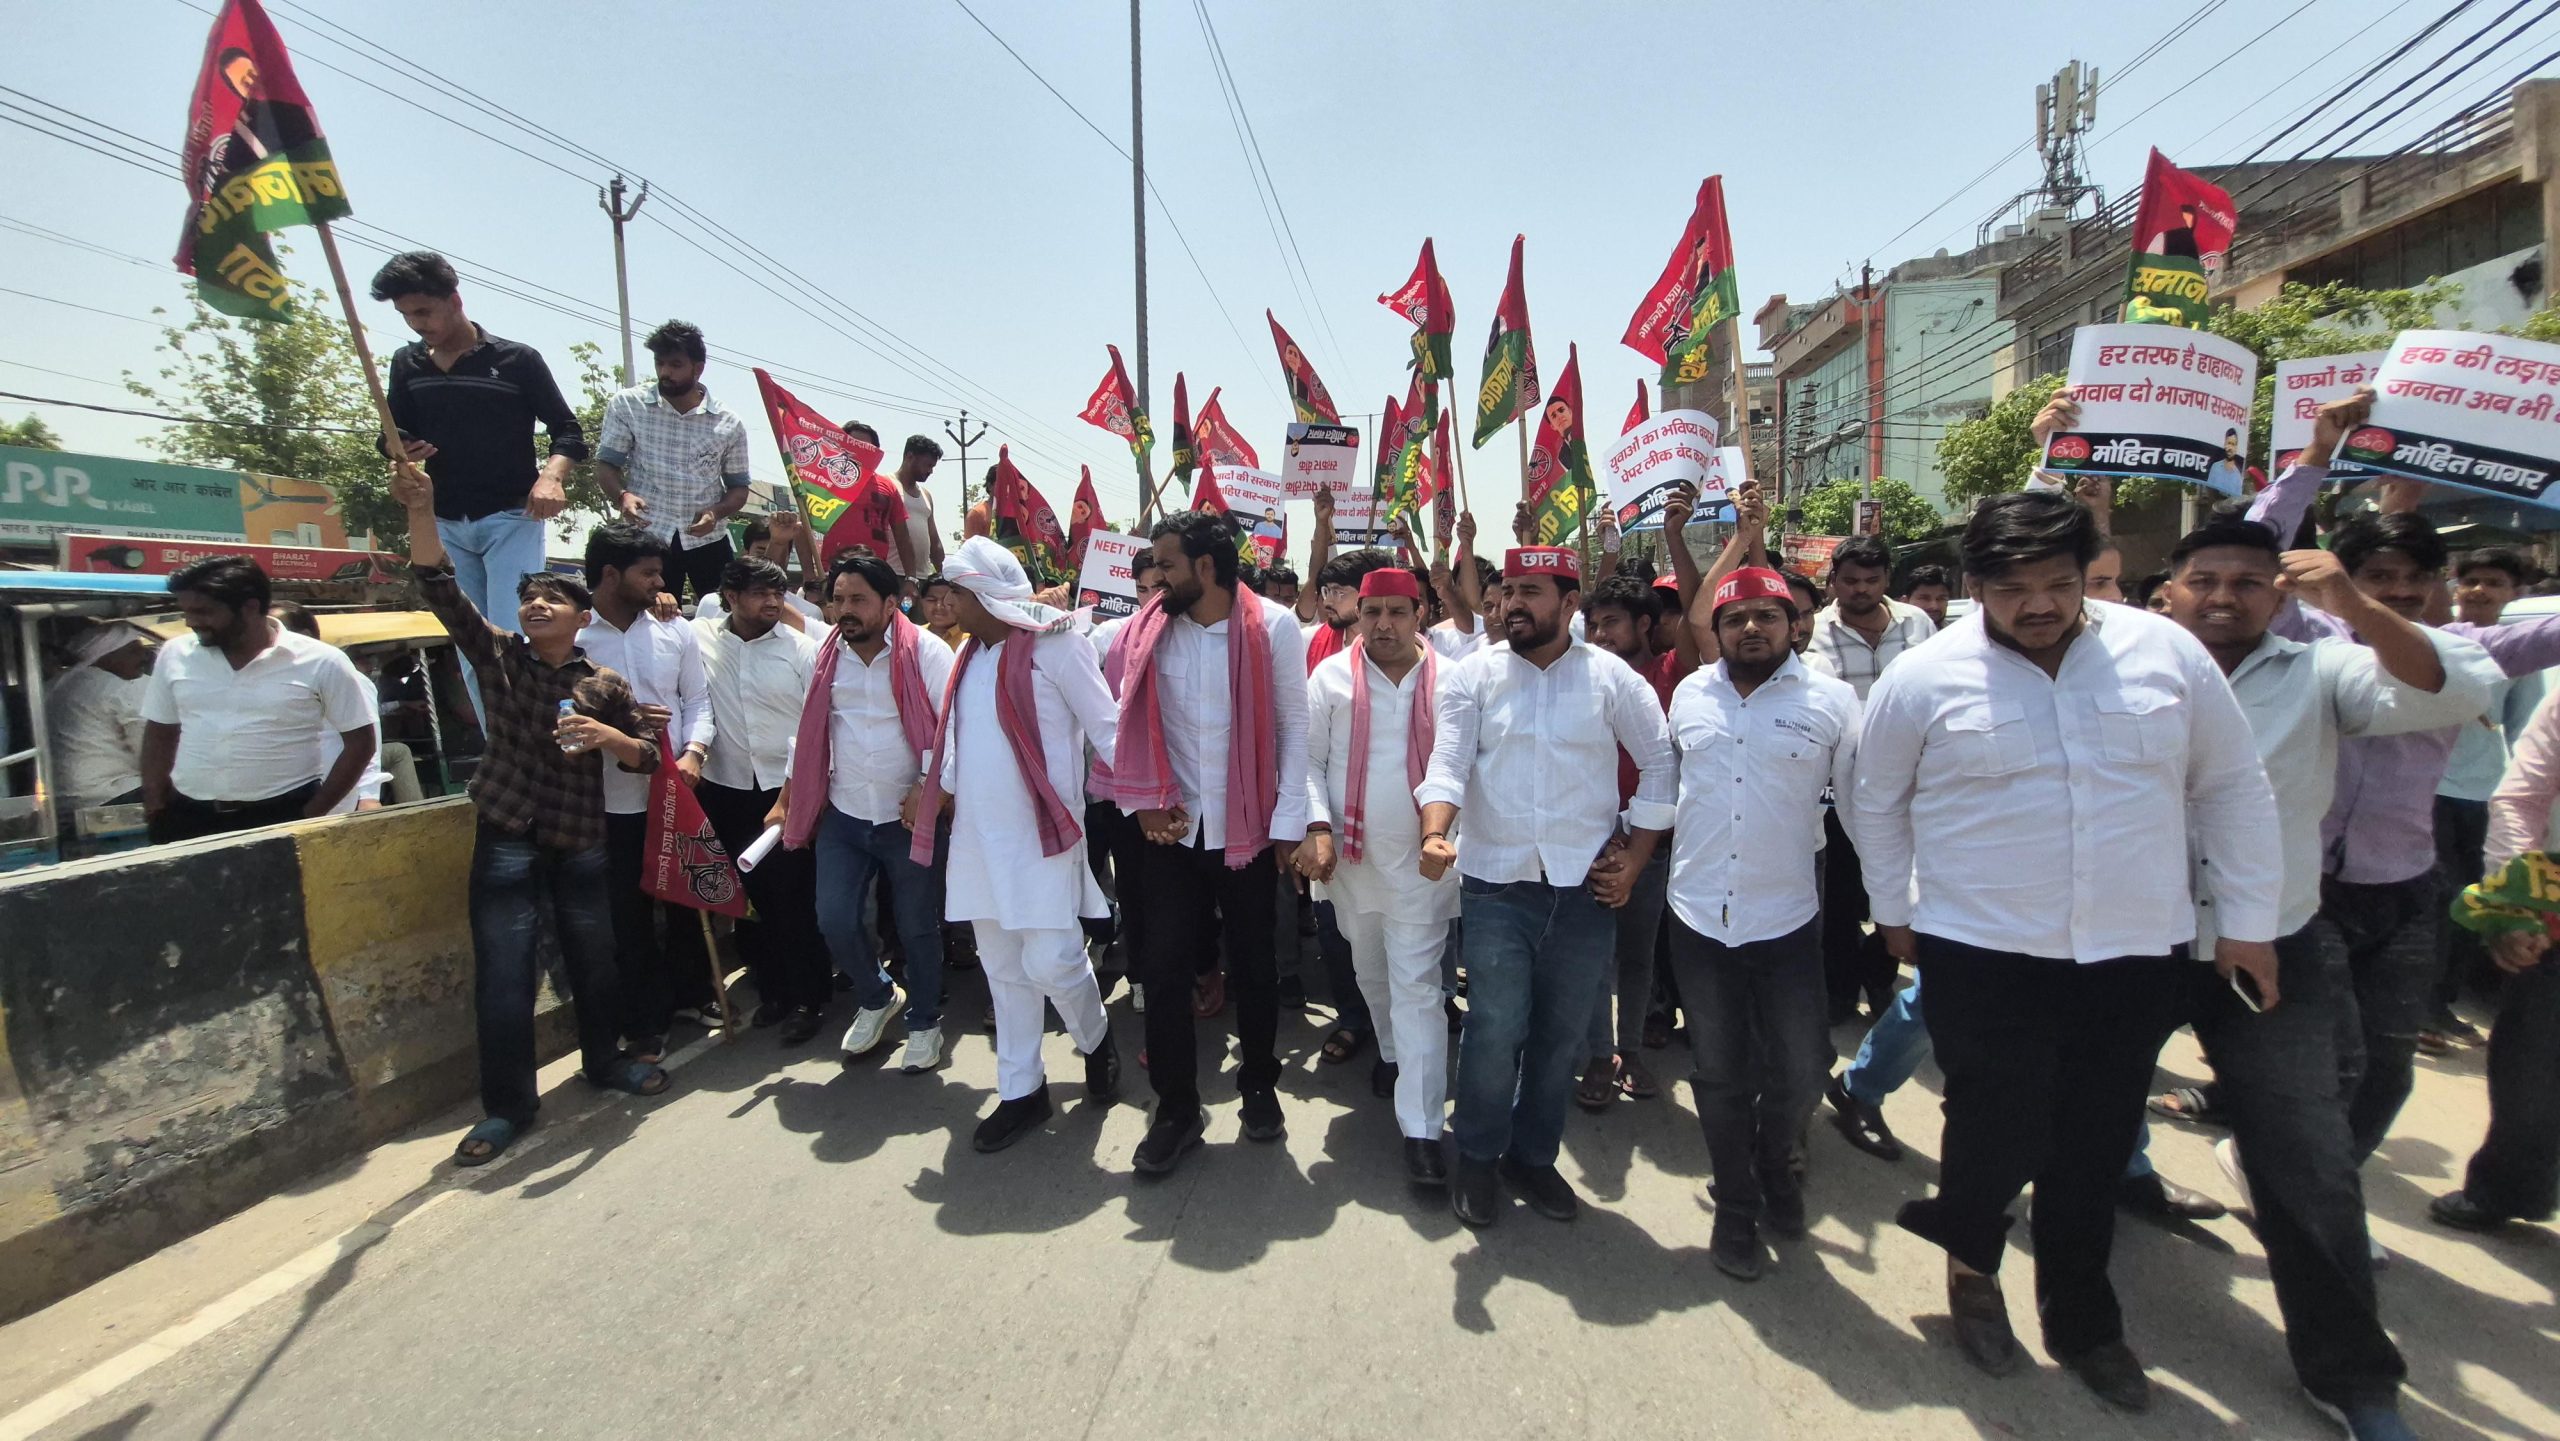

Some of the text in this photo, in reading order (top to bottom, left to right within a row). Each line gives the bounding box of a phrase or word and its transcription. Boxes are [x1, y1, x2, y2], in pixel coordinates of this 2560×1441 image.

[2099, 343, 2244, 386] हर तरफ है हाहाकार
[2400, 346, 2453, 365] हक
[2453, 344, 2494, 371] की
[2286, 365, 2337, 390] छात्रों
[2340, 363, 2367, 384] के
[2069, 384, 2125, 403] जवाब
[2129, 377, 2153, 403] दो
[2155, 384, 2209, 412] भाजपा
[2387, 379, 2467, 406] जनता
[2465, 391, 2518, 414] अब
[2516, 393, 2555, 421] भी
[1325, 429, 1347, 443] मोहित
[1609, 435, 1642, 474] युवाओं
[1641, 428, 1660, 446] का
[1660, 418, 1699, 437] भविष्य
[1621, 461, 1643, 484] पेपर
[1643, 449, 1674, 471] लीक
[2091, 439, 2211, 474] मोहित नागर
[2392, 440, 2549, 491] मोहित नागर
[1219, 484, 1241, 497] ाहिए
[1236, 470, 1249, 482] की
[1250, 475, 1280, 491] सरकार
[1705, 474, 1726, 491] दो
[806, 493, 847, 520] ार्टी
[1351, 492, 1371, 502] बेरोज
[1639, 486, 1681, 513] मोहि
[1236, 516, 1255, 527] ागर
[1335, 509, 1347, 517] वाब
[1094, 539, 1126, 555] NEET
[1357, 533, 1378, 542] नार
[272, 552, 311, 563] BHARAT
[1519, 552, 1560, 567] छात्र
[1099, 596, 1132, 614] मोहित
